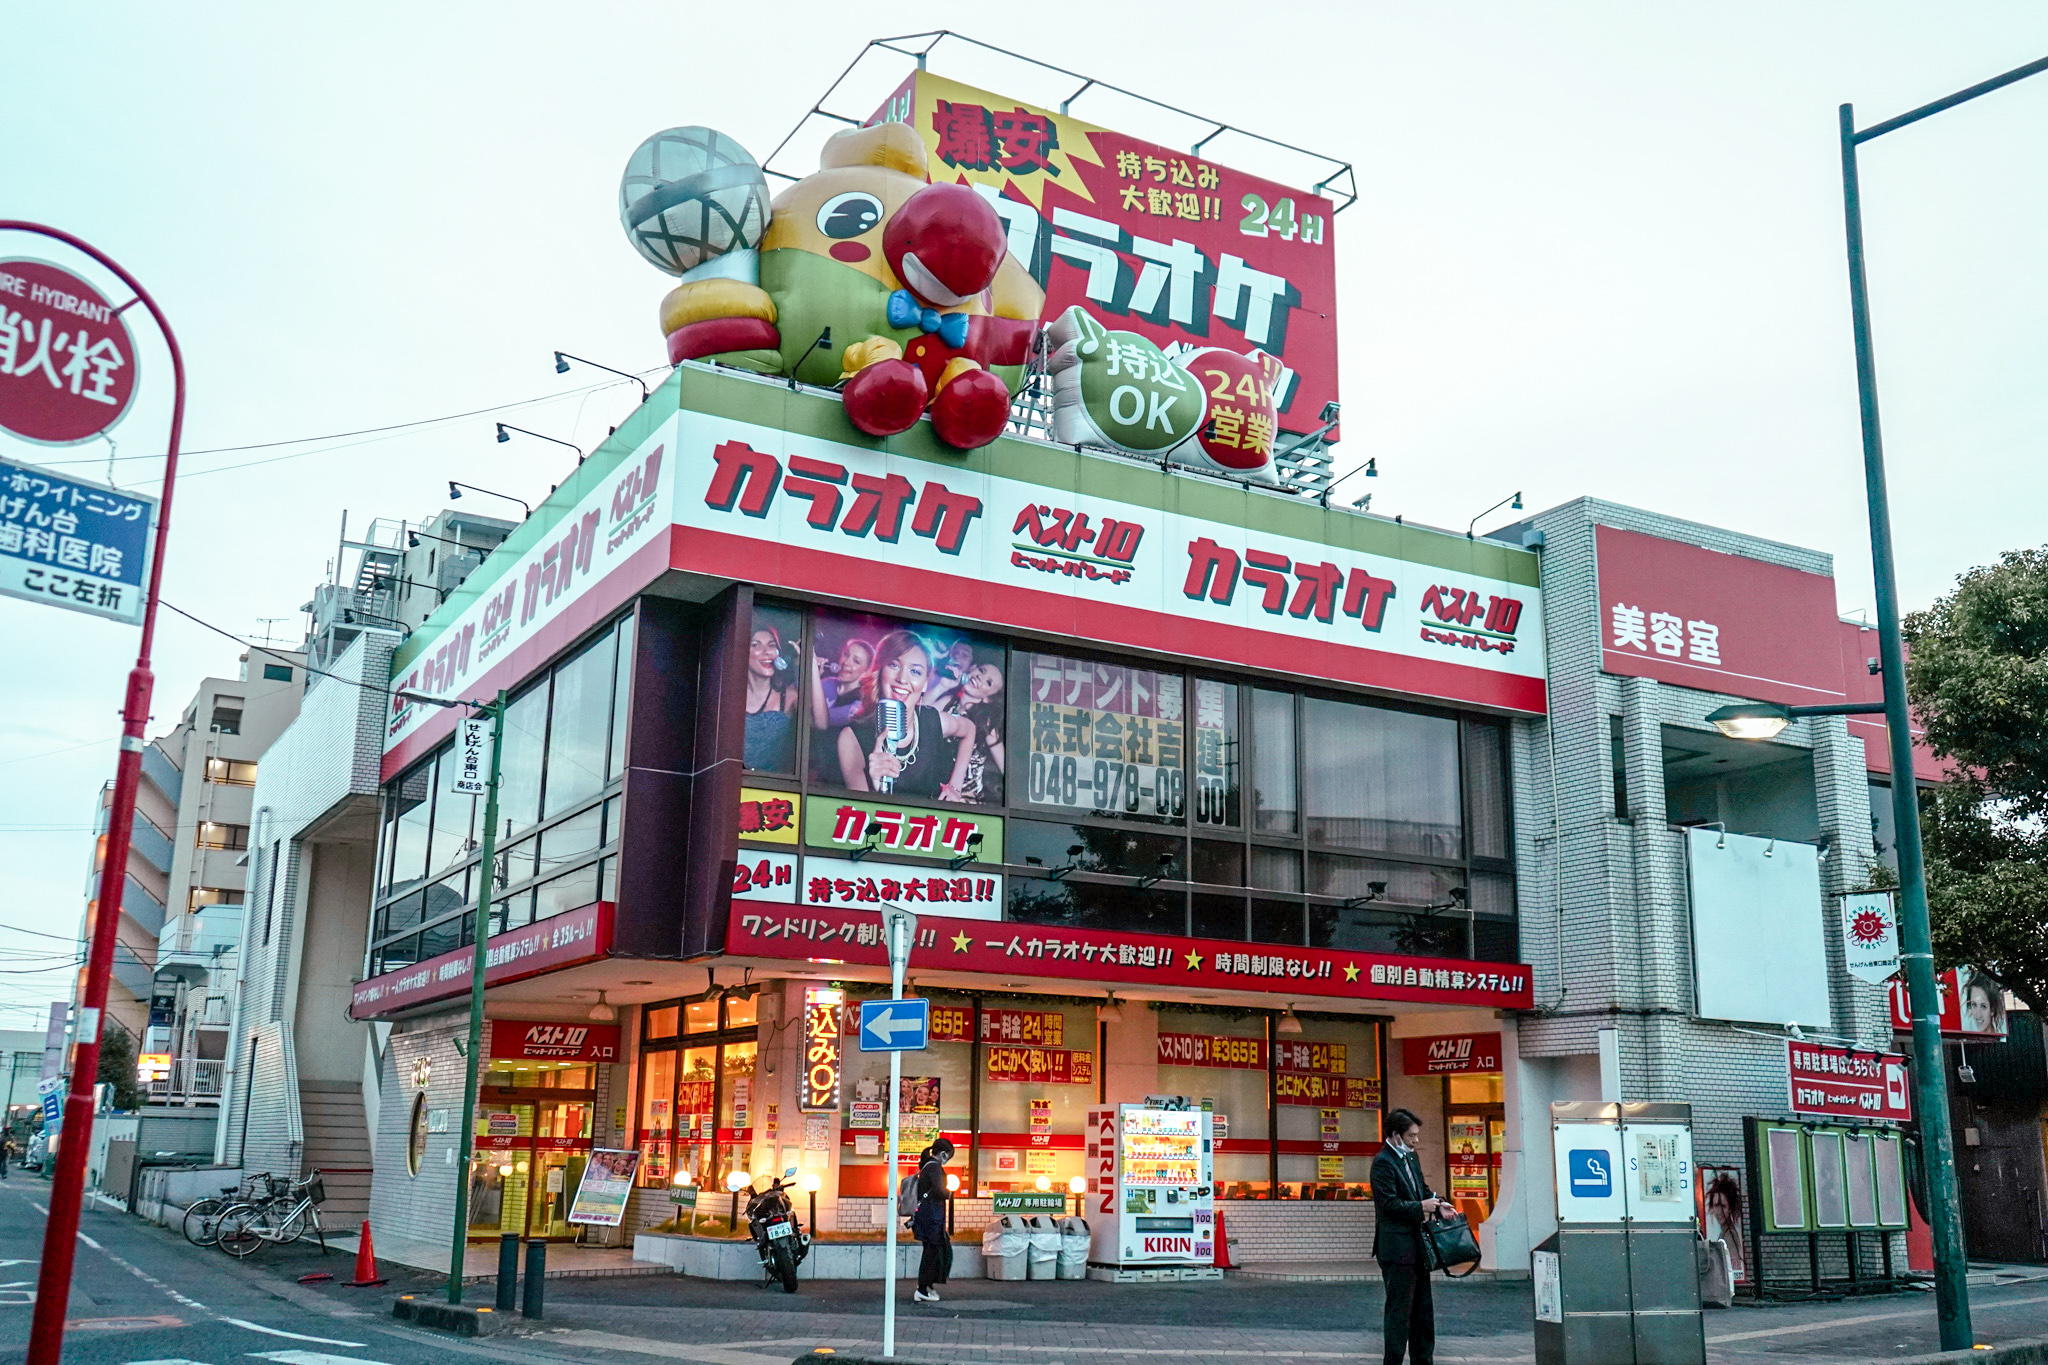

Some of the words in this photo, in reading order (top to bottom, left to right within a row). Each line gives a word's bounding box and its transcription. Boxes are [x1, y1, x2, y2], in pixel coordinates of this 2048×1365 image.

[932, 99, 1061, 178] 爆安
[1117, 150, 1220, 190] 持ち込み
[1120, 184, 1222, 223] 大歓迎!!
[1240, 192, 1324, 246] 24H
[0, 271, 27, 297] IRE
[31, 283, 112, 324] HYDRANT
[1106, 338, 1187, 392] 持込
[1109, 384, 1178, 435] OK
[1210, 404, 1273, 455] 営業
[704, 439, 984, 556] カラオケ
[1012, 502, 1145, 563] ベスト10
[24, 568, 122, 610] ここ左折
[521, 507, 601, 628] カラオケ
[1010, 550, 1131, 586] ヒットパレード
[1183, 536, 1396, 633] カラオケ
[1420, 582, 1524, 635] ベスト10
[1611, 602, 1722, 666] 美容室
[1420, 626, 1515, 657] ヒットパレード
[456, 780, 482, 791] 商店会
[832, 805, 978, 856] カラオケ
[985, 935, 1172, 967] 一人カラオケ大歓迎!!
[1215, 953, 1331, 980] 時間制限なし!!
[1370, 964, 1524, 993] 個別自動精算システム!!
[524, 1025, 588, 1046] ベスト10
[590, 1045, 613, 1058] 入口
[1428, 1038, 1473, 1059] ベスト10
[1476, 1056, 1495, 1069] 入口
[1797, 1087, 1826, 1106] カラオケ
[1100, 1111, 1115, 1214] KIRIN
[1195, 1214, 1212, 1223] 100
[1144, 1237, 1192, 1253] KIRIN
[1195, 1247, 1212, 1256] 100
